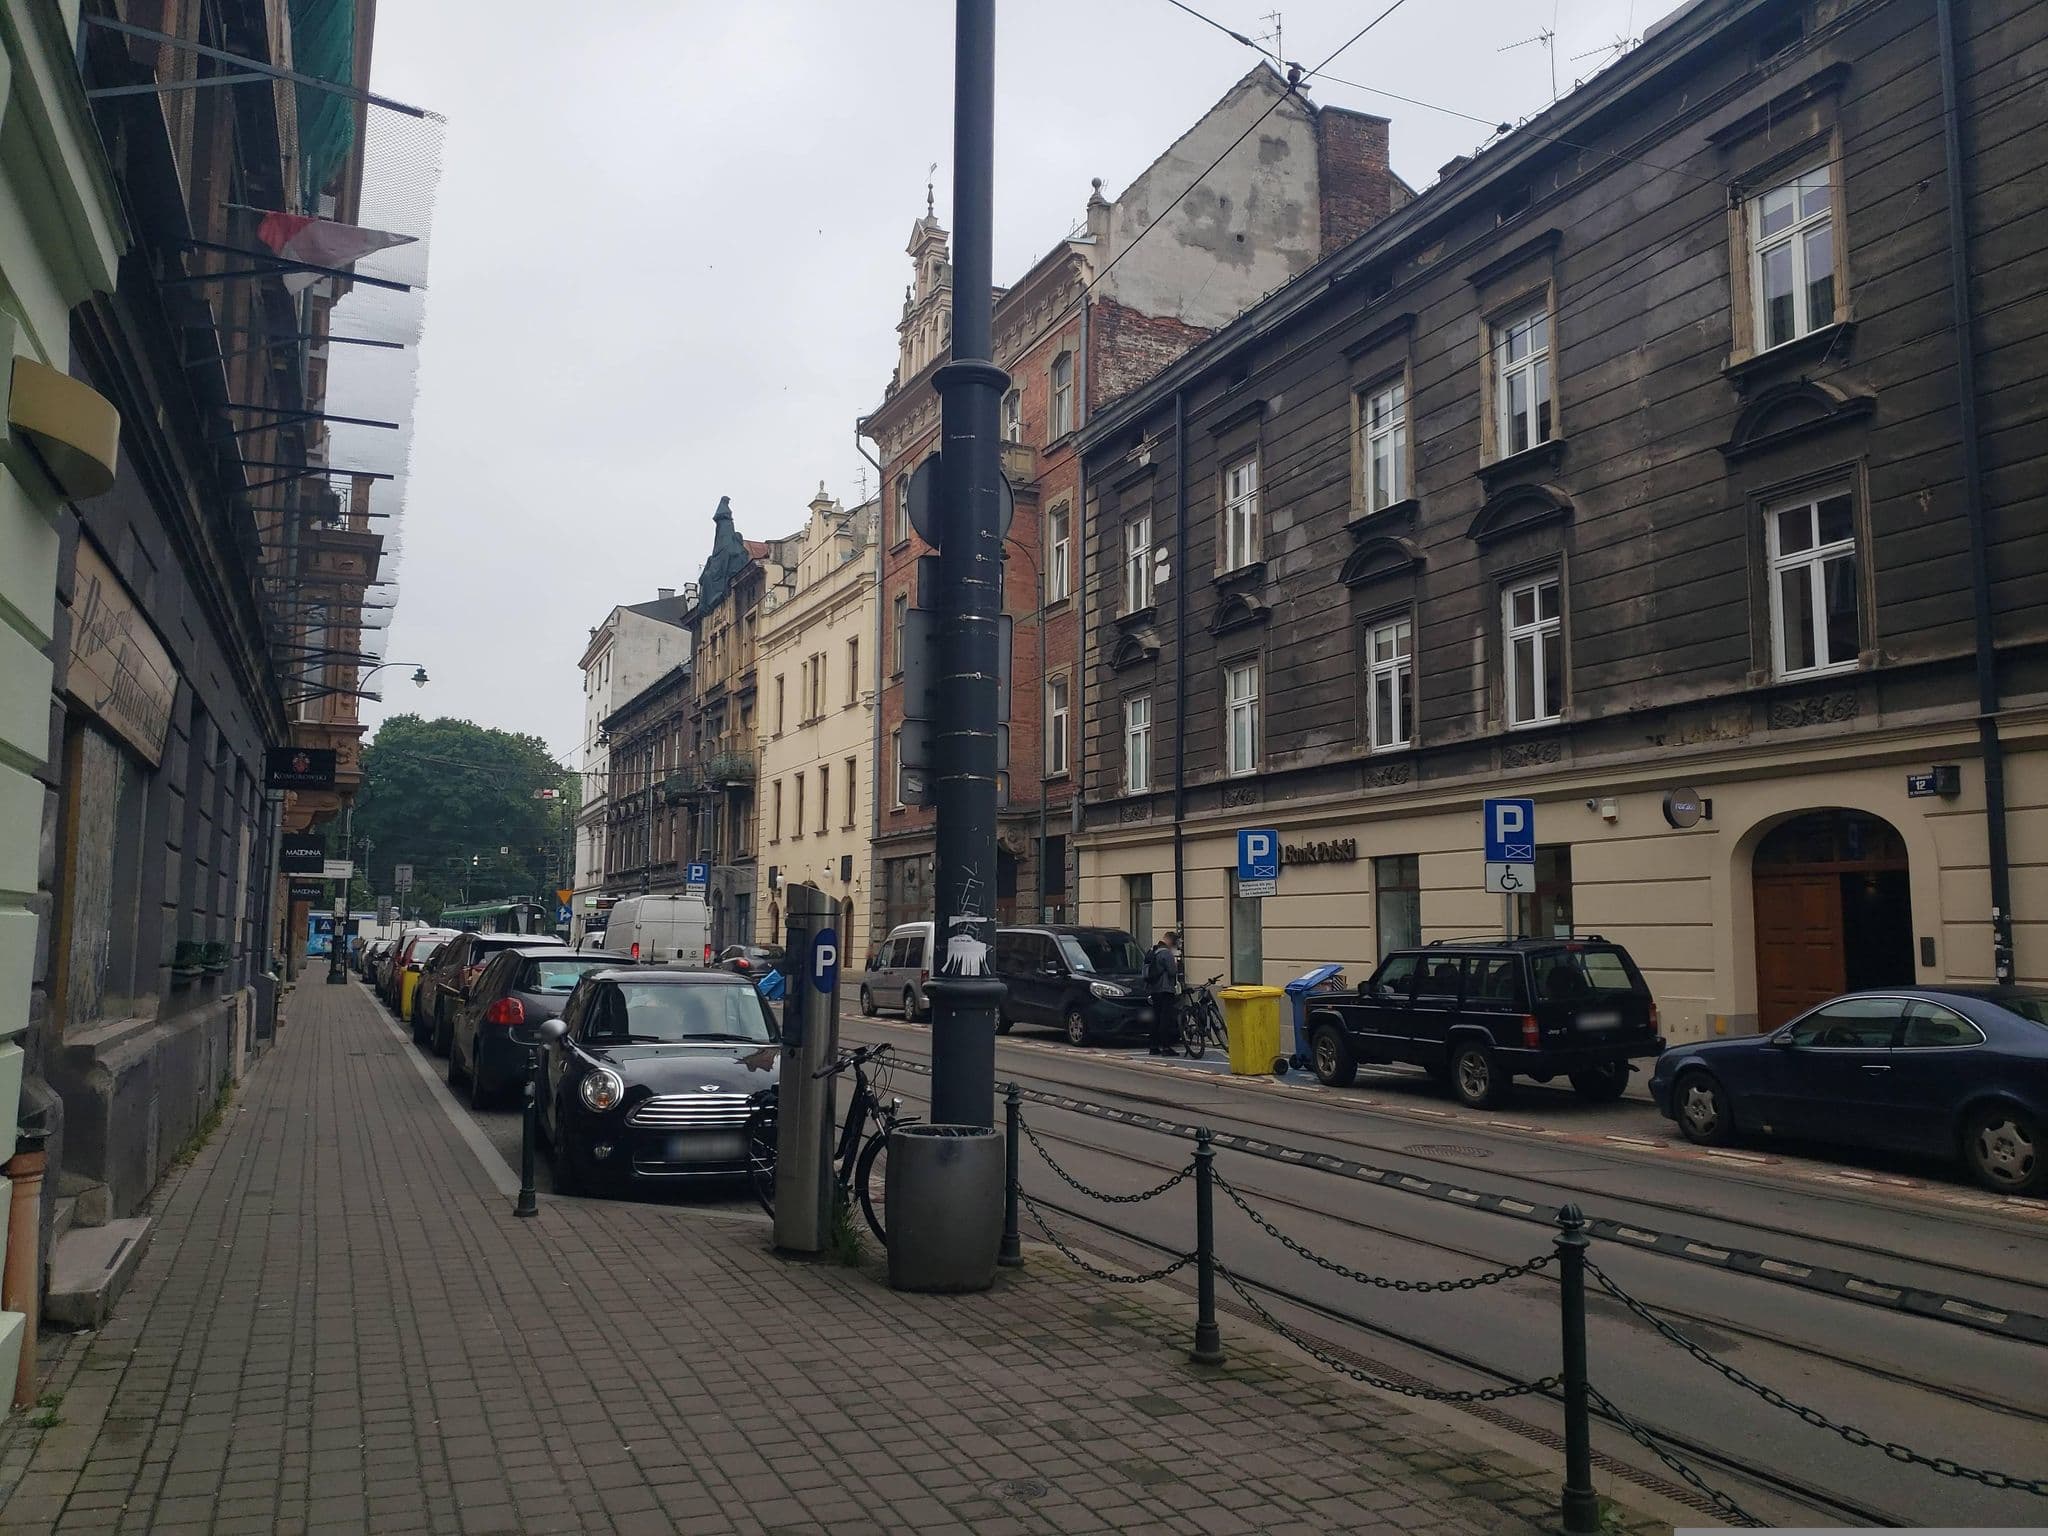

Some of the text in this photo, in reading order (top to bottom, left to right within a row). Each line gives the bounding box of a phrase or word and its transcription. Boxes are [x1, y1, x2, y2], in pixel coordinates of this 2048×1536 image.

[1916, 781, 1926, 790] 12
[1497, 805, 1523, 842] P
[1248, 835, 1269, 864] P
[691, 865, 703, 880] P
[816, 945, 836, 976] P
